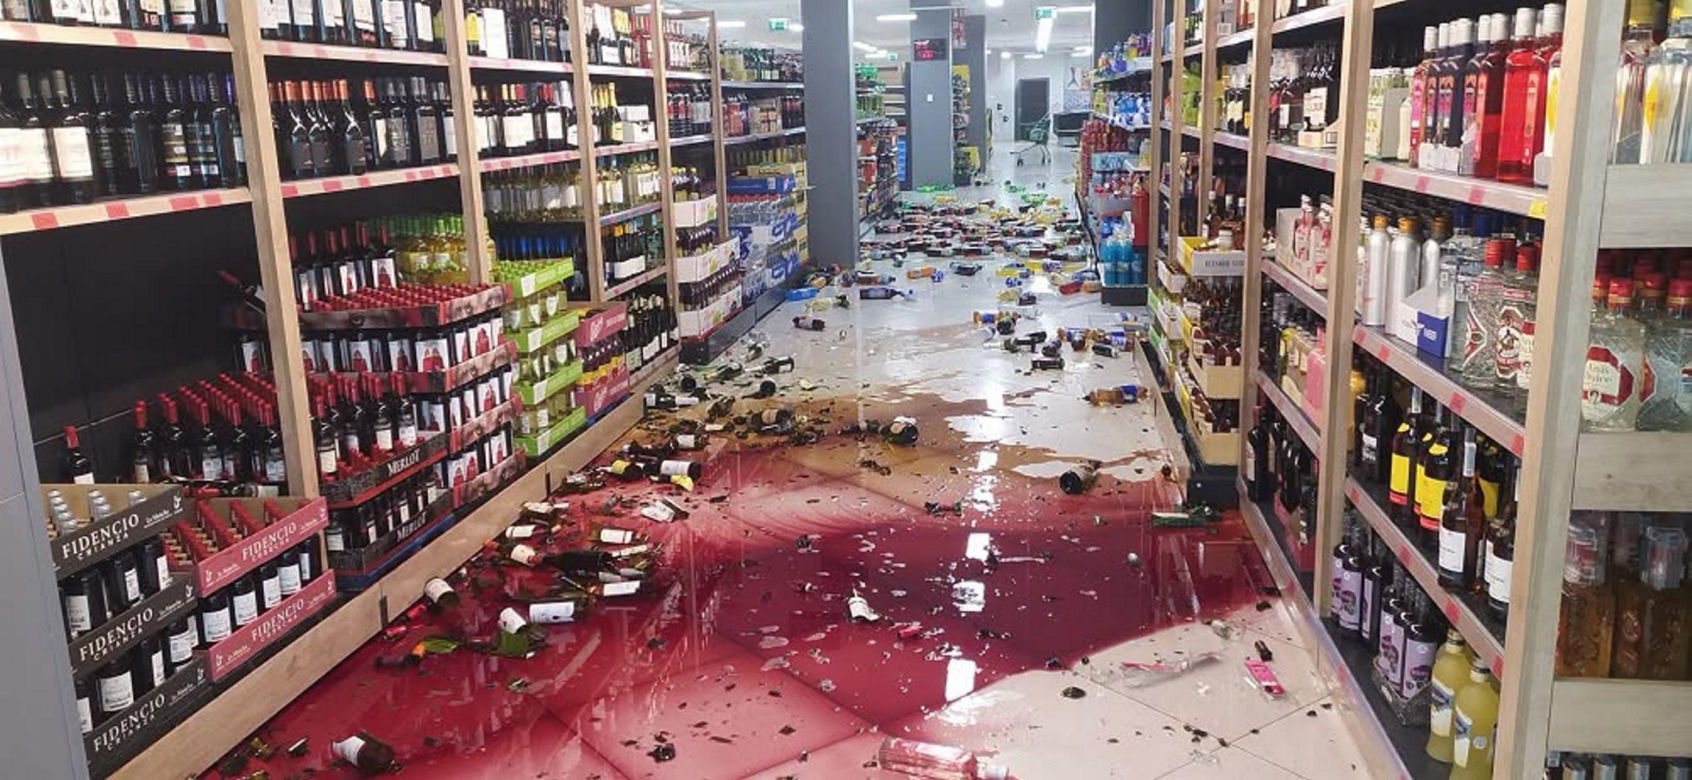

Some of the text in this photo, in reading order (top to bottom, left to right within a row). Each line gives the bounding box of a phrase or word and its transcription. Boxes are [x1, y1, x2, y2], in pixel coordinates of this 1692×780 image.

[387, 448, 420, 476] MERLOT
[62, 514, 139, 559] FIDENCIO
[242, 522, 297, 561] FIDENCIO
[80, 607, 153, 661] FIDENCIO
[251, 599, 304, 641] FIDENCIO
[93, 693, 165, 752] FIDENCIO
